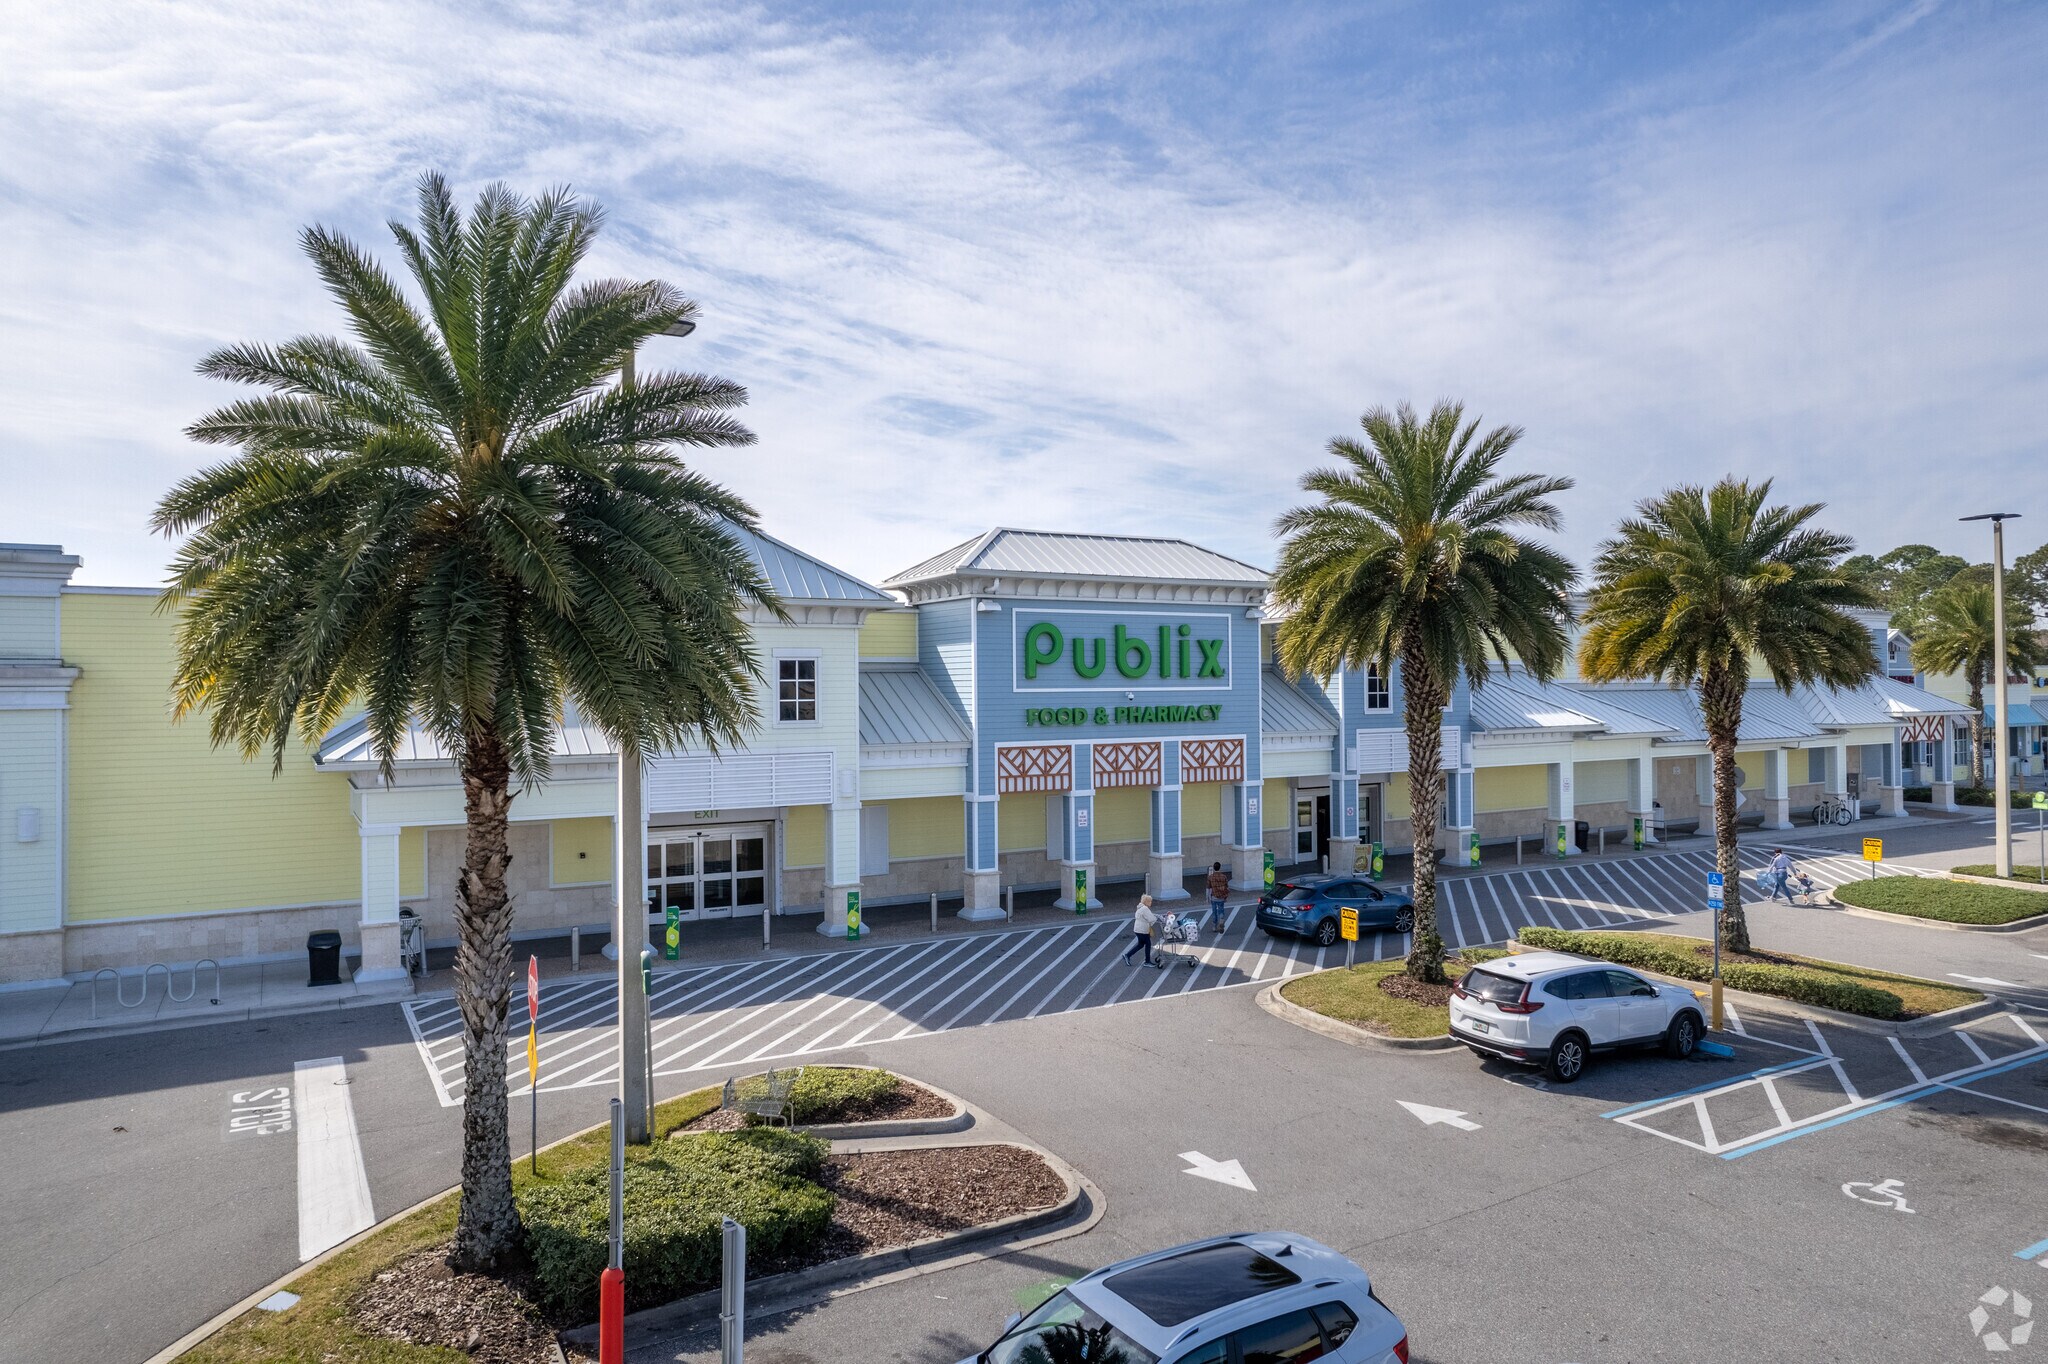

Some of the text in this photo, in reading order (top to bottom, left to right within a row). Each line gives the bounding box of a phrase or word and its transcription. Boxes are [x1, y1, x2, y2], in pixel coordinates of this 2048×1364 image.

[1025, 622, 1225, 680] Publix
[1026, 704, 1223, 727] FOOD & PHARMACY
[694, 809, 719, 819] EXIT
[229, 1087, 292, 1135] STOP
